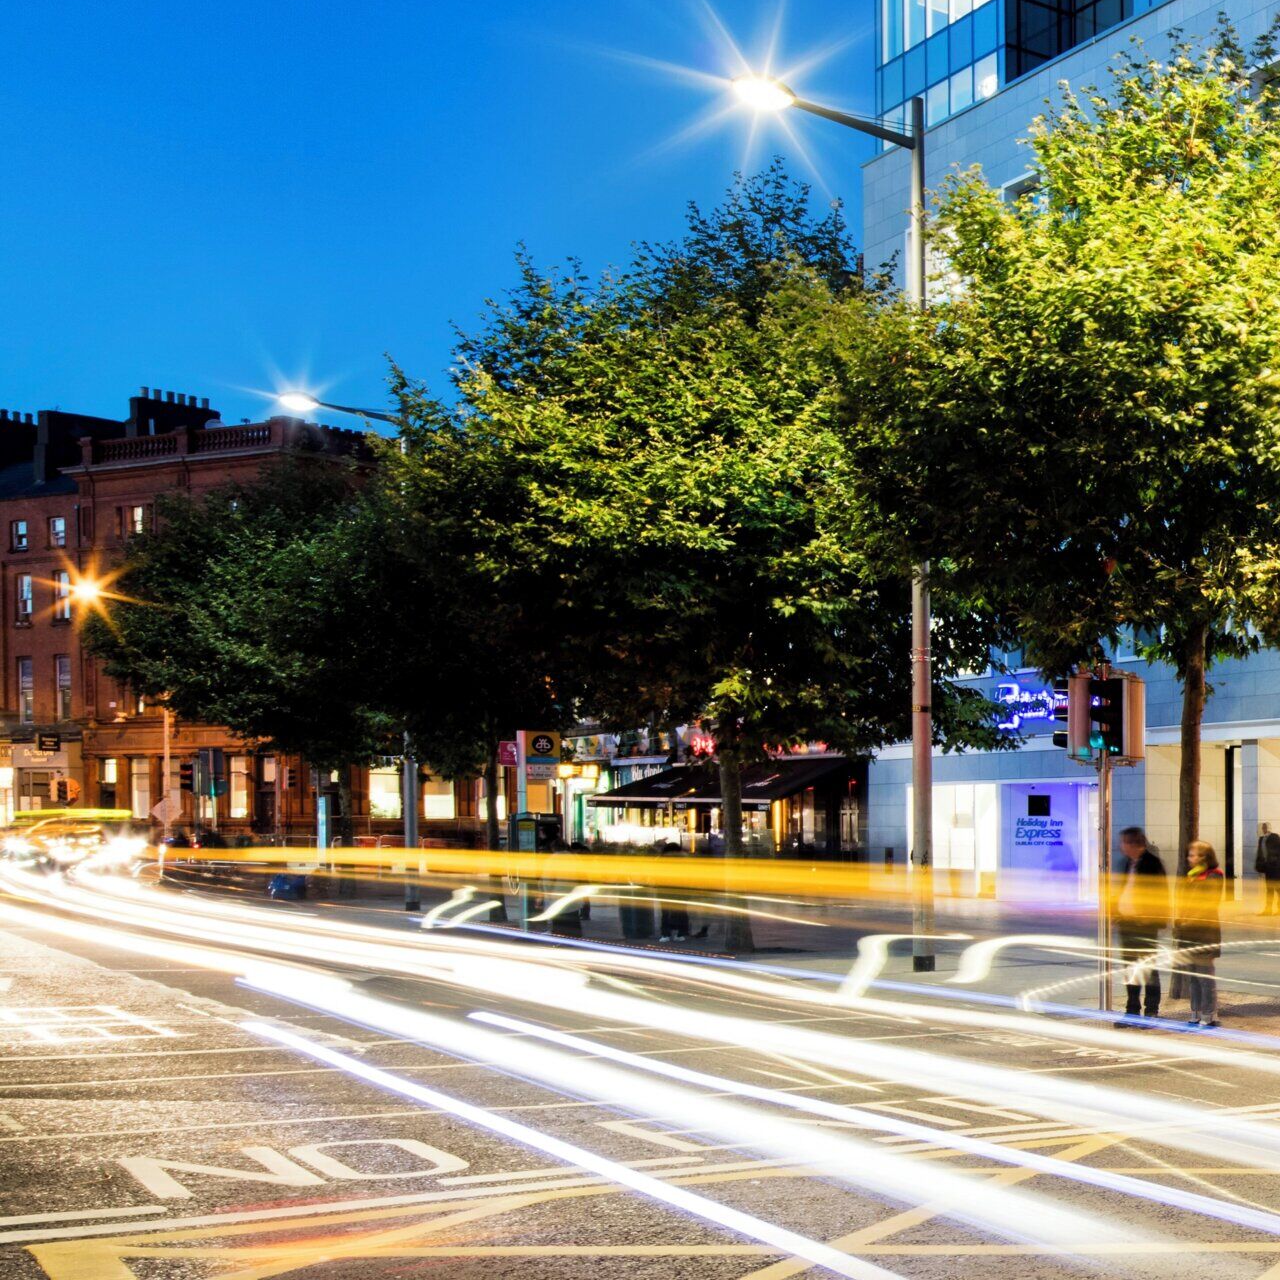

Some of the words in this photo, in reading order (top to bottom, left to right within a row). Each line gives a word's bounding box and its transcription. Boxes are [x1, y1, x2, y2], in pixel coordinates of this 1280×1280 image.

[1016, 818, 1048, 828] Holiday
[1015, 827, 1061, 841] Express
[116, 1138, 470, 1199] NO
